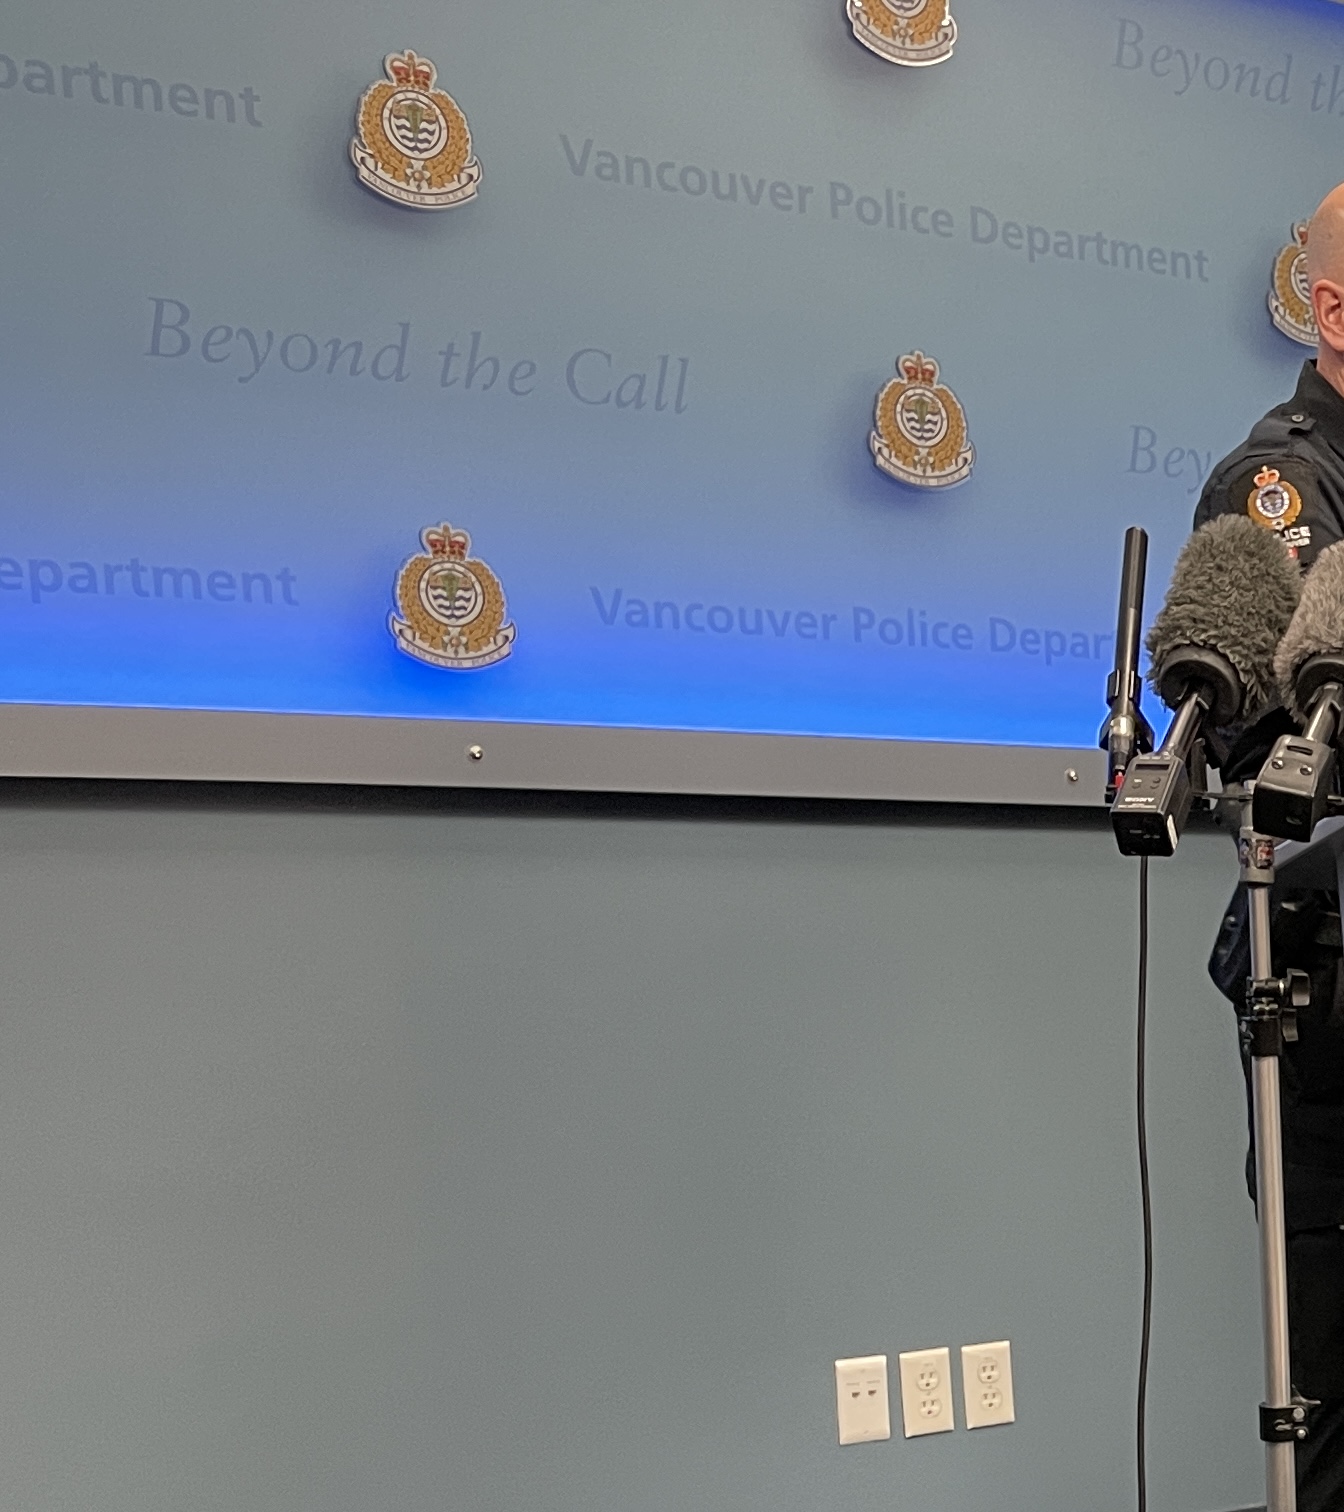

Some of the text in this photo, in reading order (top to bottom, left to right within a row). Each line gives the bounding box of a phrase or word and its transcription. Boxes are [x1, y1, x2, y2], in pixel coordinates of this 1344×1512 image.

[1112, 15, 1294, 107] Beyond
[559, 133, 1210, 284] Vancouver Police Department
[143, 295, 691, 416] Beyond the Call
[1128, 423, 1212, 495] Bey
[588, 585, 1114, 667] Vancouver Police Depar
